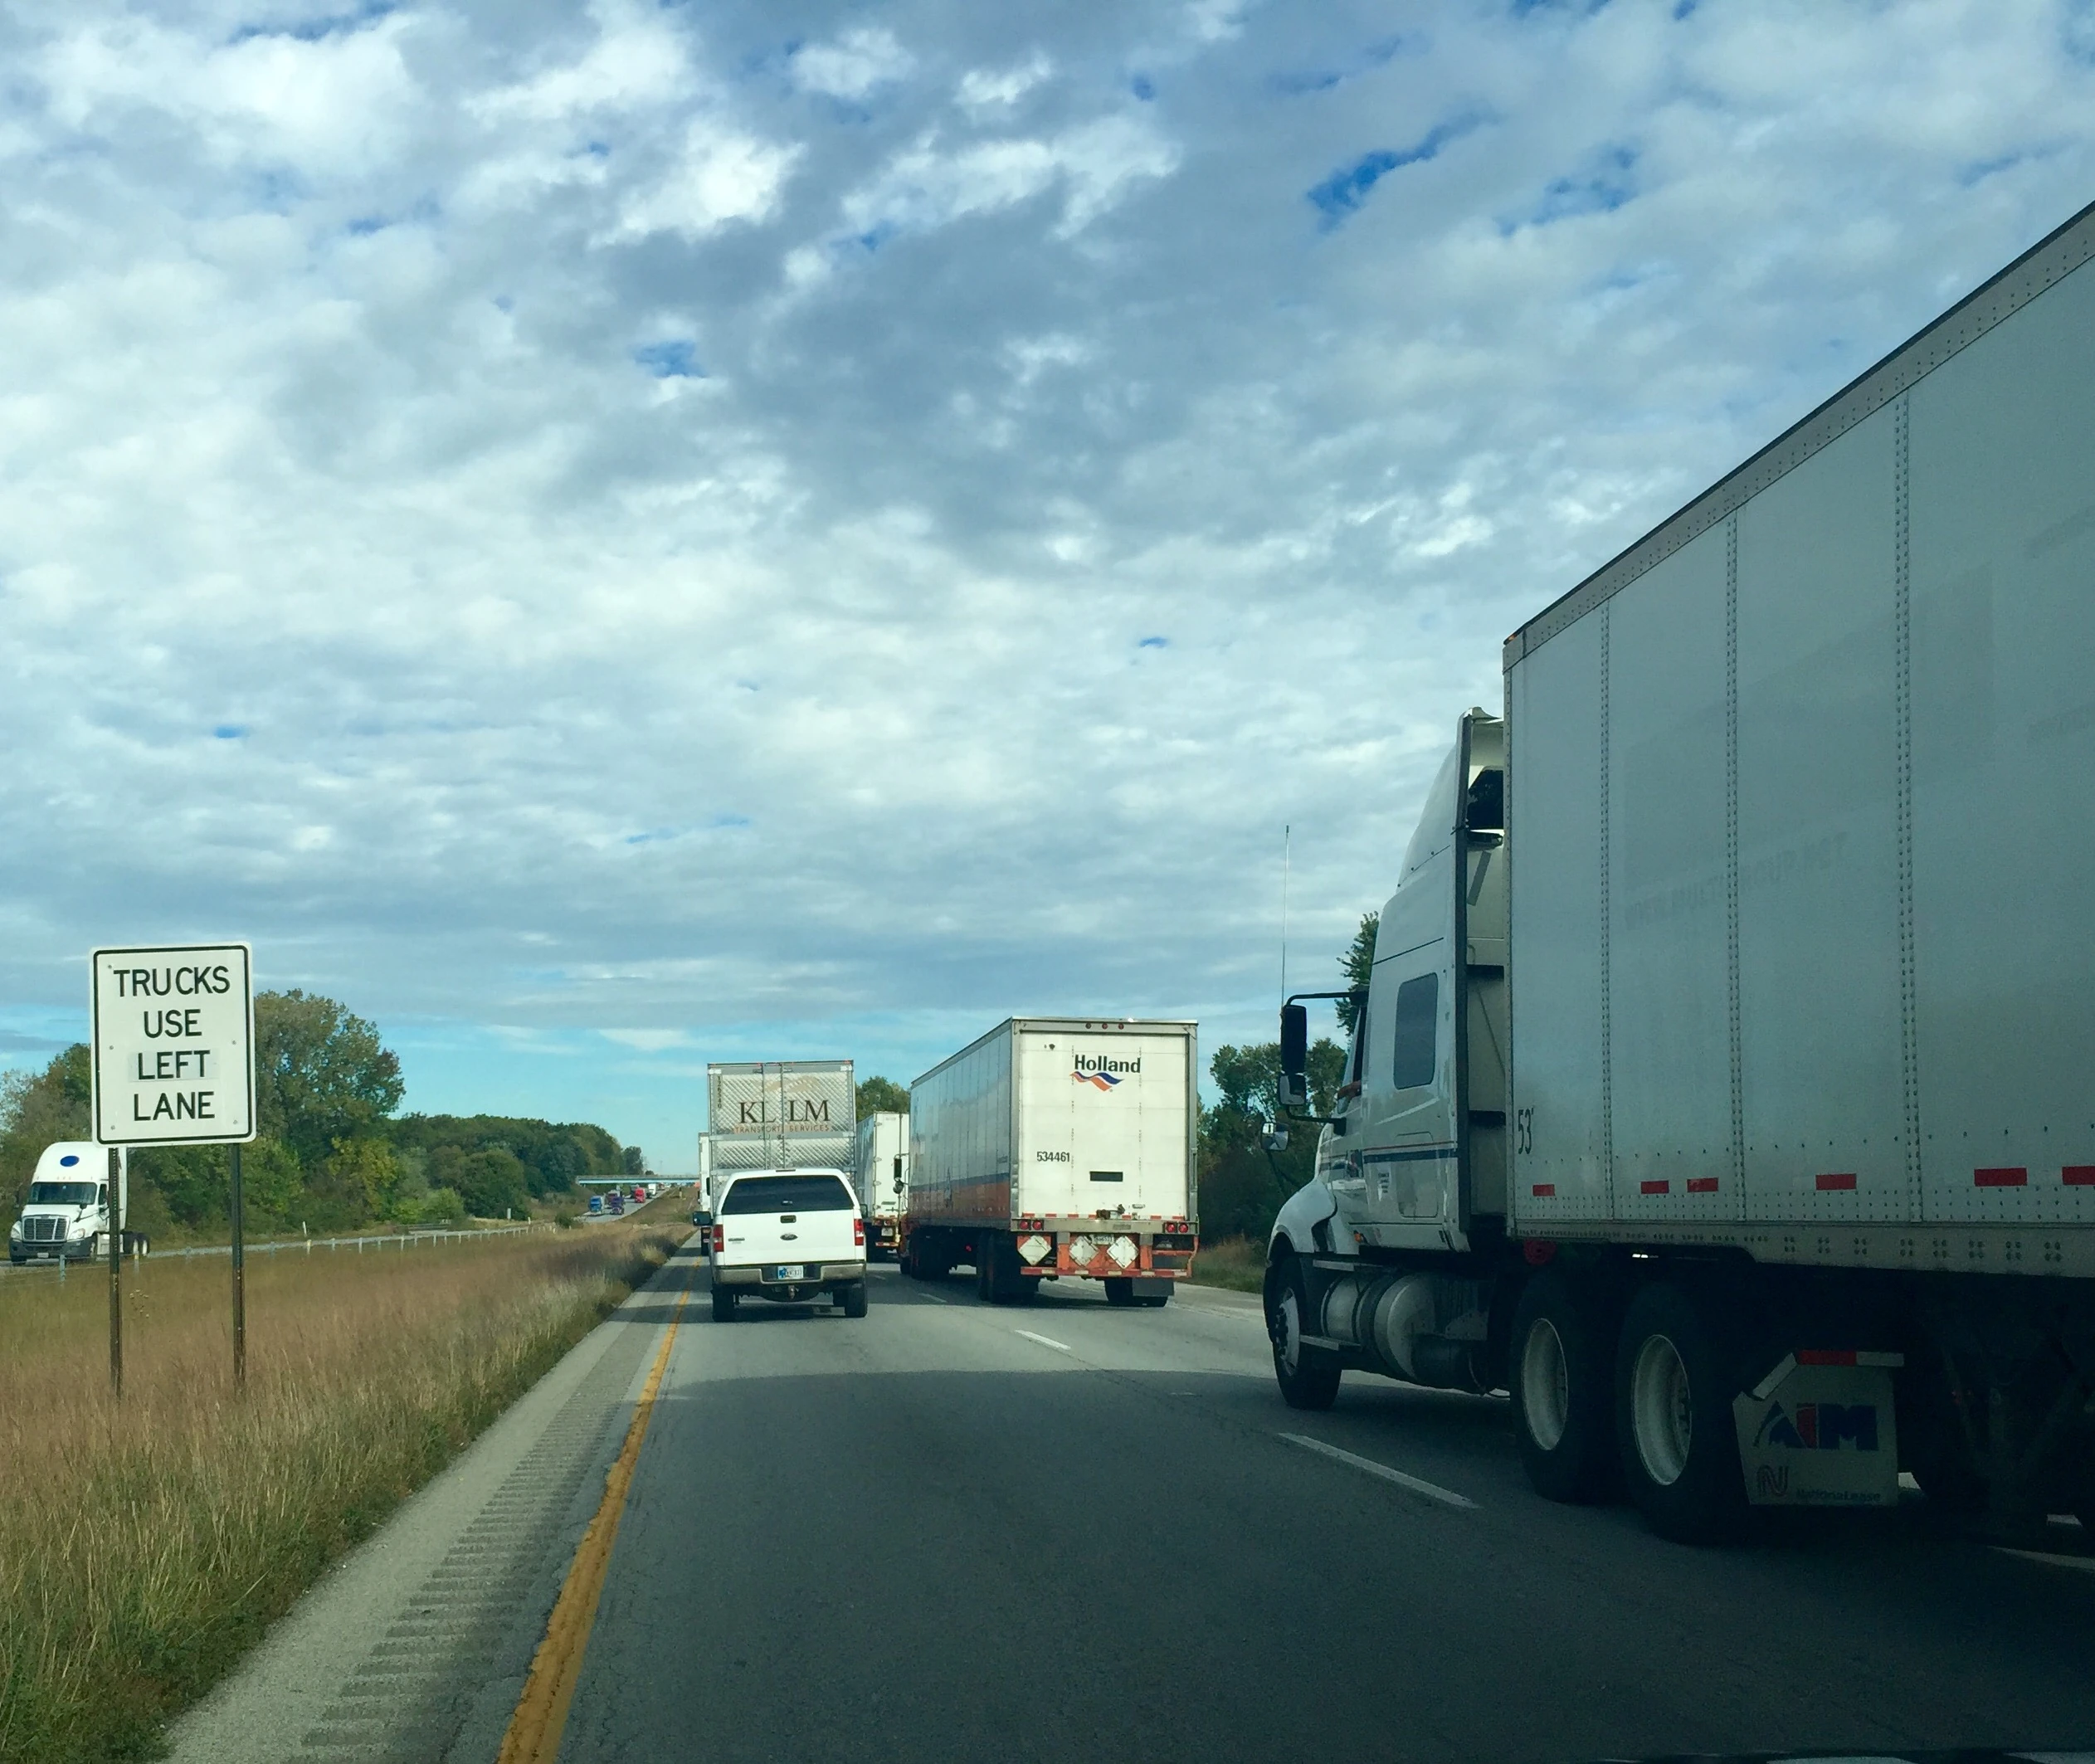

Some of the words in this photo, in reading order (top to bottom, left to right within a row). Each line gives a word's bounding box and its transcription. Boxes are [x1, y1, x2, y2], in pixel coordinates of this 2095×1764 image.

[114, 966, 230, 997] TRUCKS
[144, 1009, 202, 1039] USE
[138, 1050, 211, 1080] LEFT
[1074, 1054, 1142, 1074] Holland
[134, 1091, 215, 1122] LANE
[789, 1124, 830, 1133] SERVICES
[1036, 1151, 1070, 1162] 534461
